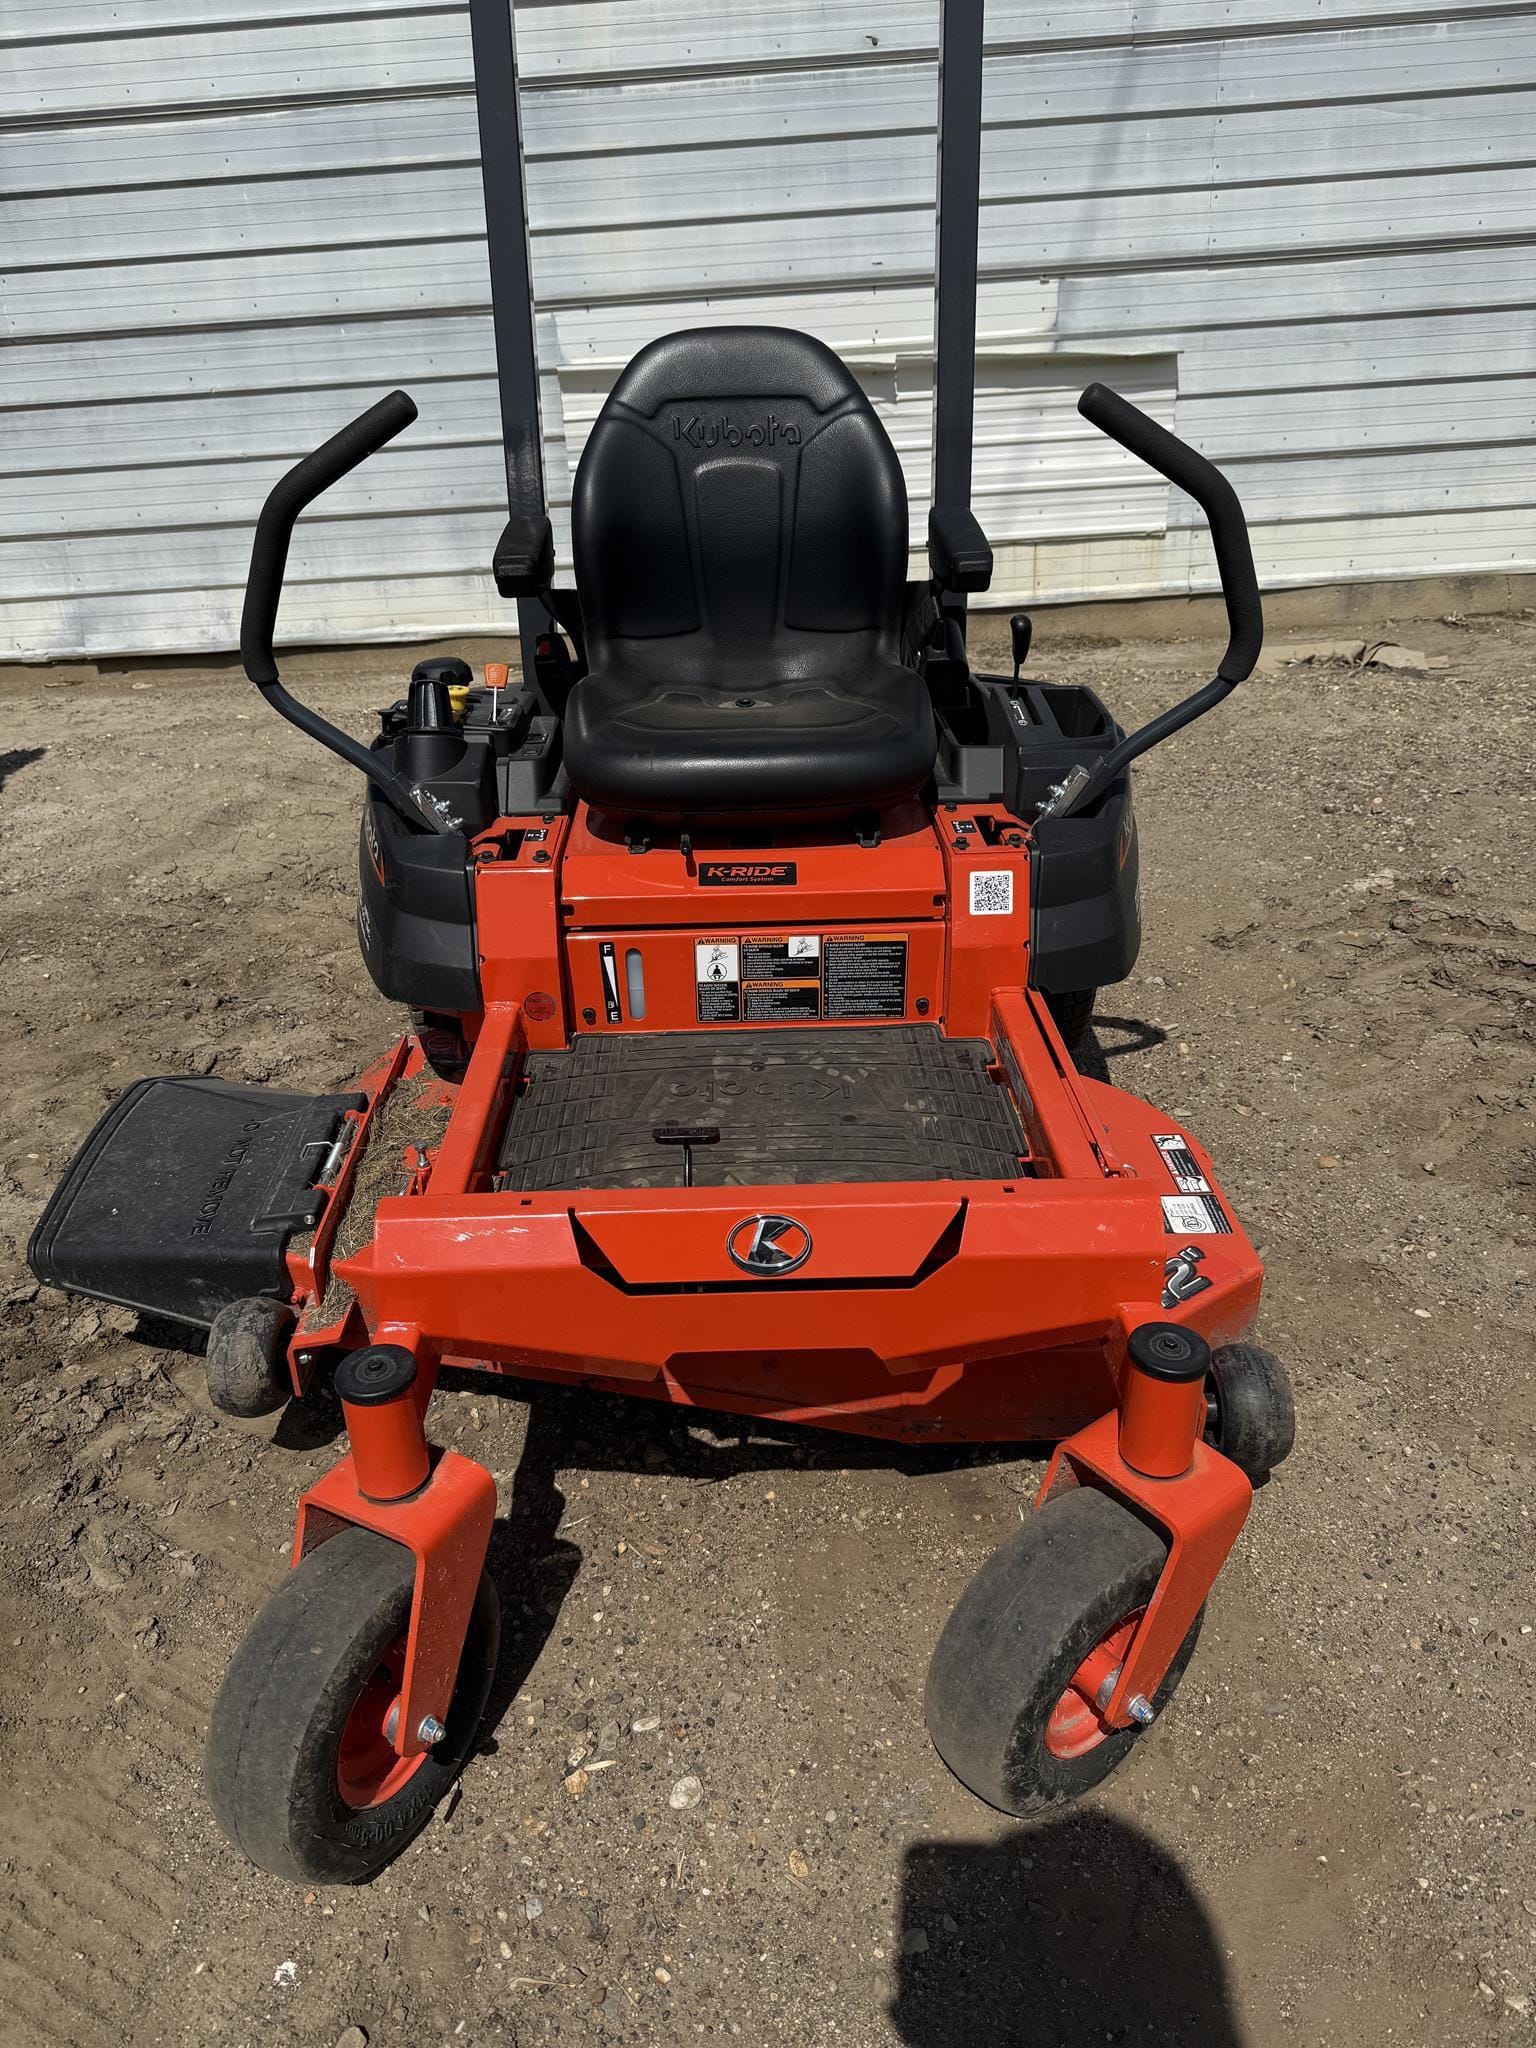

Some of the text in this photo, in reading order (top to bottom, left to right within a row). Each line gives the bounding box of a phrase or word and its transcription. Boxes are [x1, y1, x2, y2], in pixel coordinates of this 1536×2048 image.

[672, 415, 801, 449] Kubota
[707, 866, 788, 877] K-RIDE
[603, 944, 612, 954] F
[610, 1011, 619, 1021] E
[669, 1079, 851, 1102] Kubota
[223, 1137, 254, 1165] NOT
[189, 1169, 237, 1236] REMOVE
